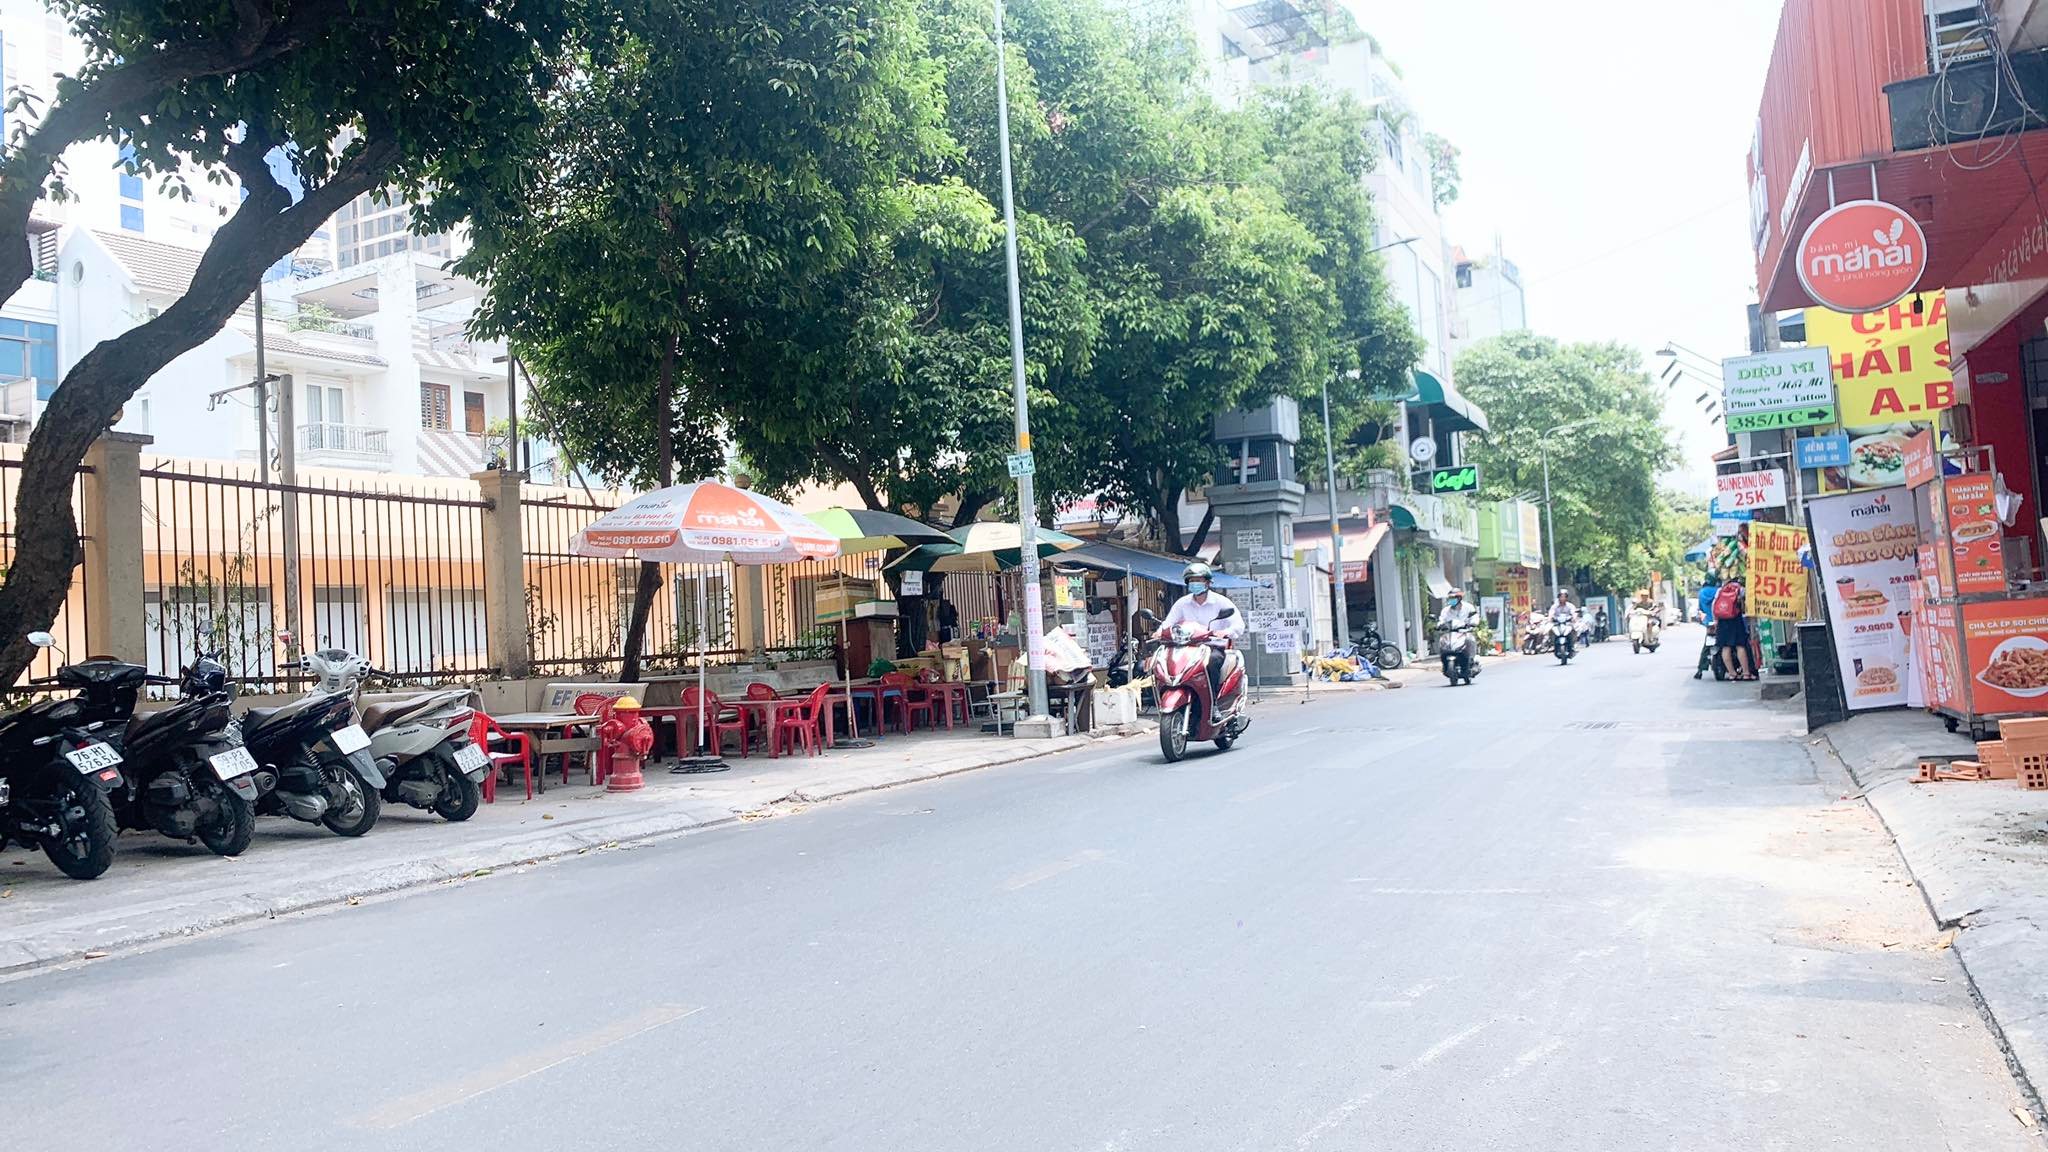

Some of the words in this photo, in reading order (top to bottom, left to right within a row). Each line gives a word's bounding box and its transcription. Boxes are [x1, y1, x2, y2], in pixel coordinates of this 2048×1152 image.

[1731, 401, 1756, 410] Phun
[1794, 393, 1828, 403] Tattoo
[1735, 488, 1767, 507] 25K
[551, 689, 573, 706] EF
[73, 745, 106, 762] 76-H1
